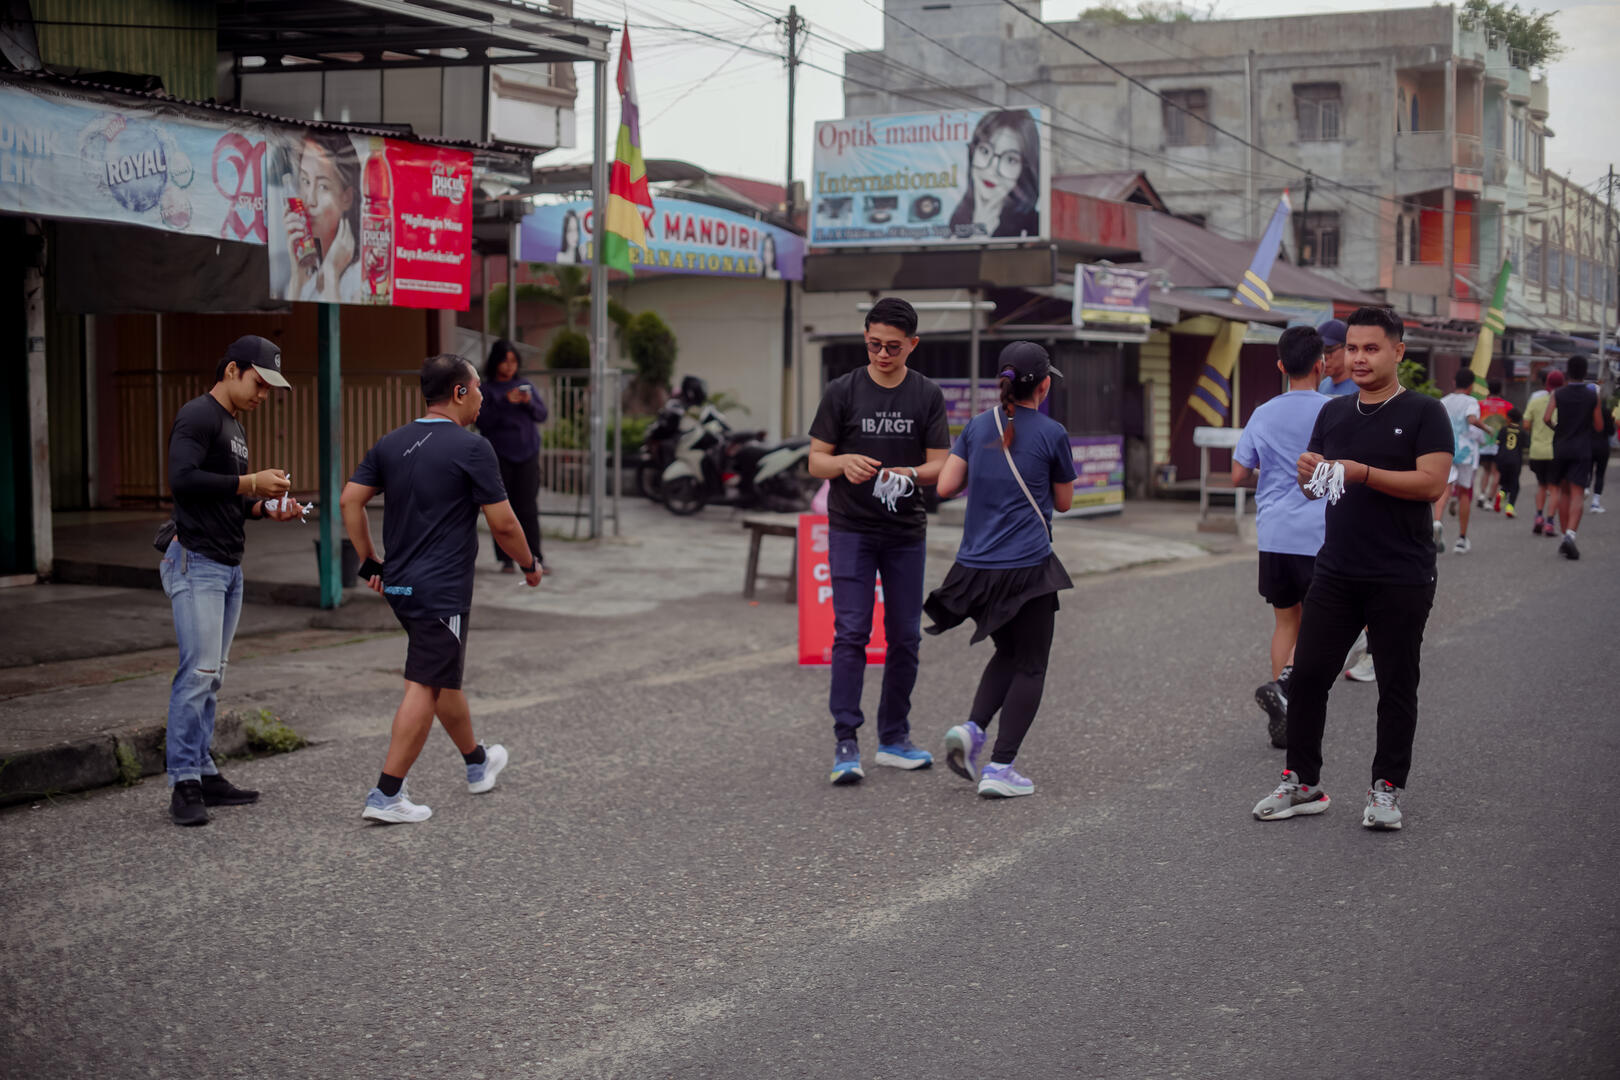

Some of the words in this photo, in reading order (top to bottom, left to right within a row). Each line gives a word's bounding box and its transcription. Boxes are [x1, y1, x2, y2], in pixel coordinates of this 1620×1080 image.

[818, 119, 878, 156] Optik
[885, 113, 970, 145] mandiri
[104, 148, 168, 188] ROYAL
[817, 164, 959, 195] International
[663, 212, 757, 251] MANDIRI
[861, 418, 915, 435] IB/RGT
[875, 411, 887, 419] WE
[888, 411, 902, 419] ARE
